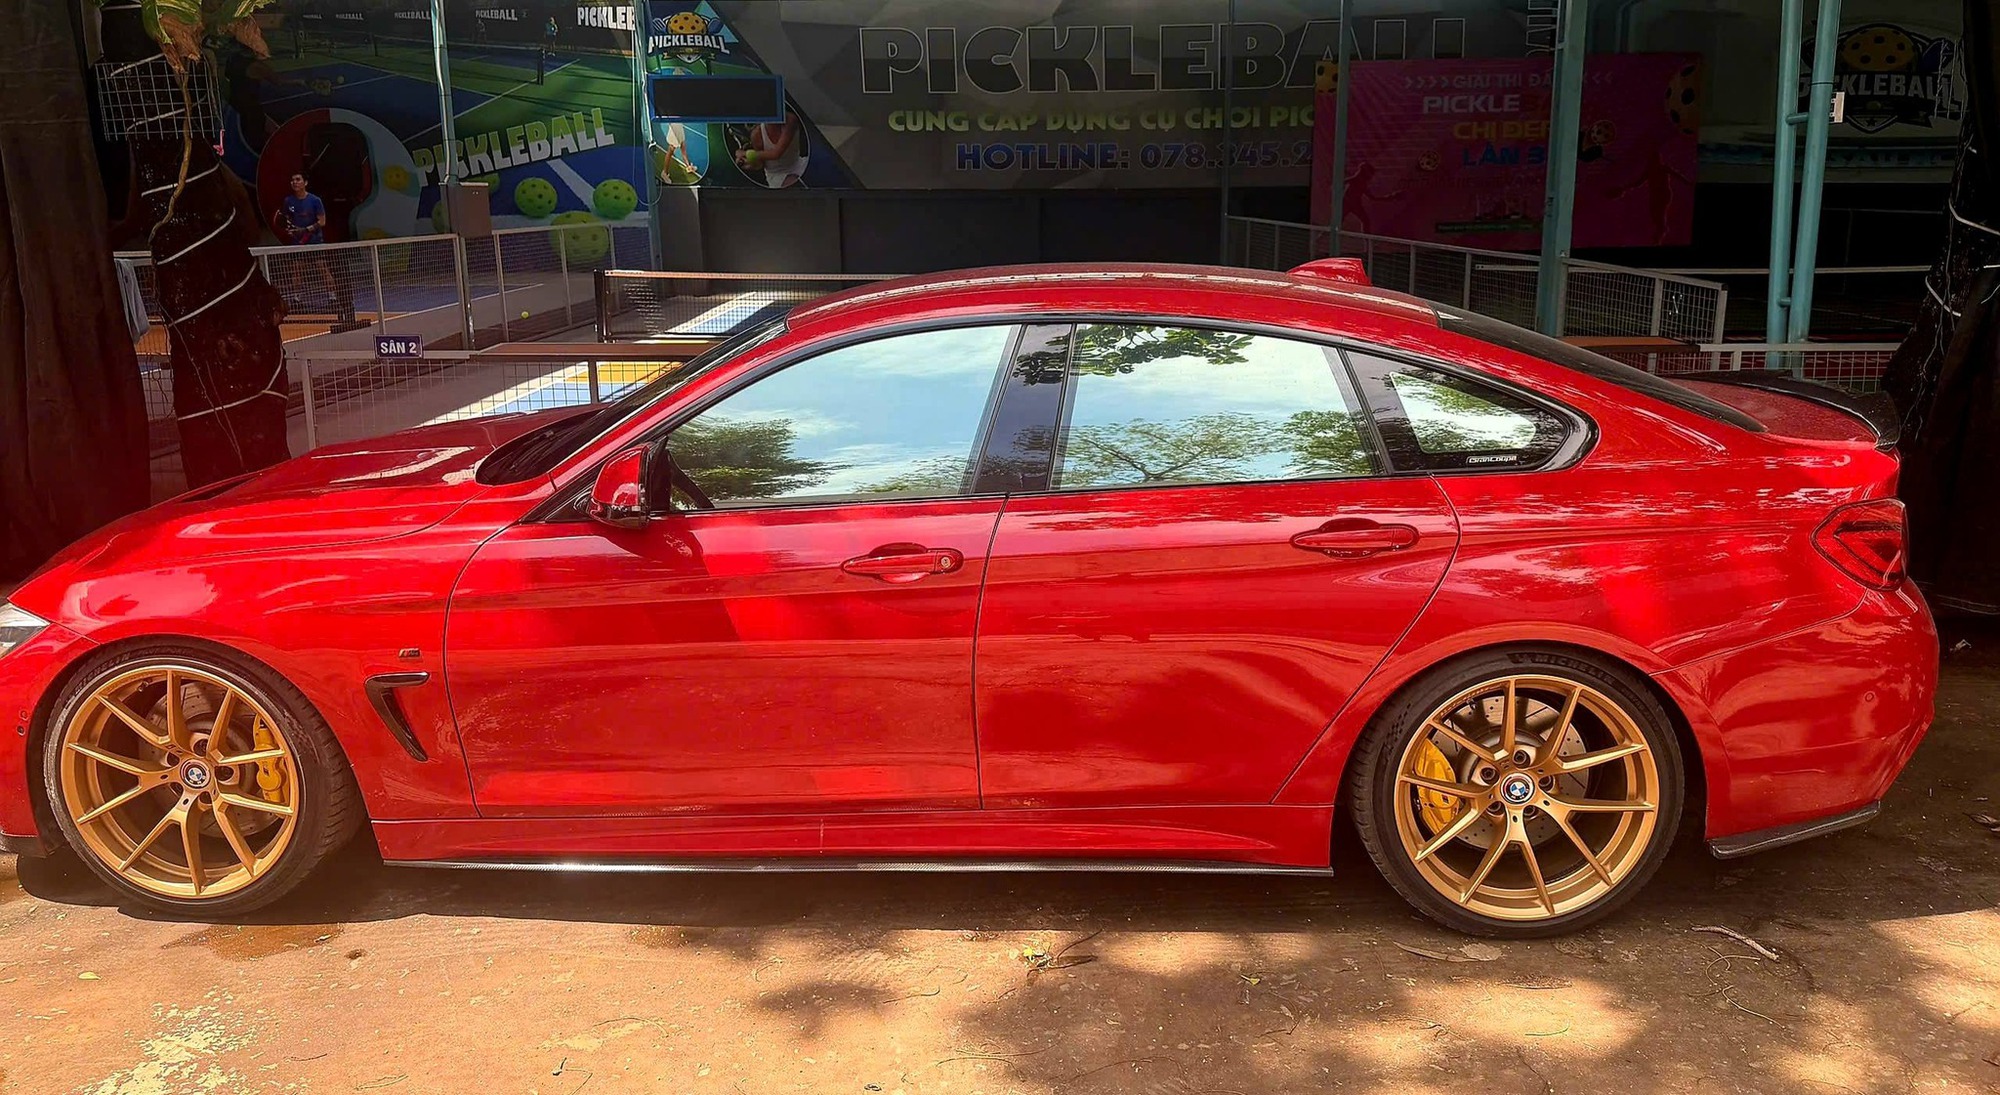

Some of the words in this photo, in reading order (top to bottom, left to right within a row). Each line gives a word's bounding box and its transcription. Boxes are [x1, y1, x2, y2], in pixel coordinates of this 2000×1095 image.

[475, 8, 518, 21] PICKLEBALL
[648, 34, 731, 55] PICKLEBALL
[1798, 74, 1963, 112] KLEBALL
[888, 110, 970, 133] CUNG
[956, 143, 1130, 171] HOTLINE:
[380, 339, 406, 354] SÂN
[408, 342, 417, 354] 2
